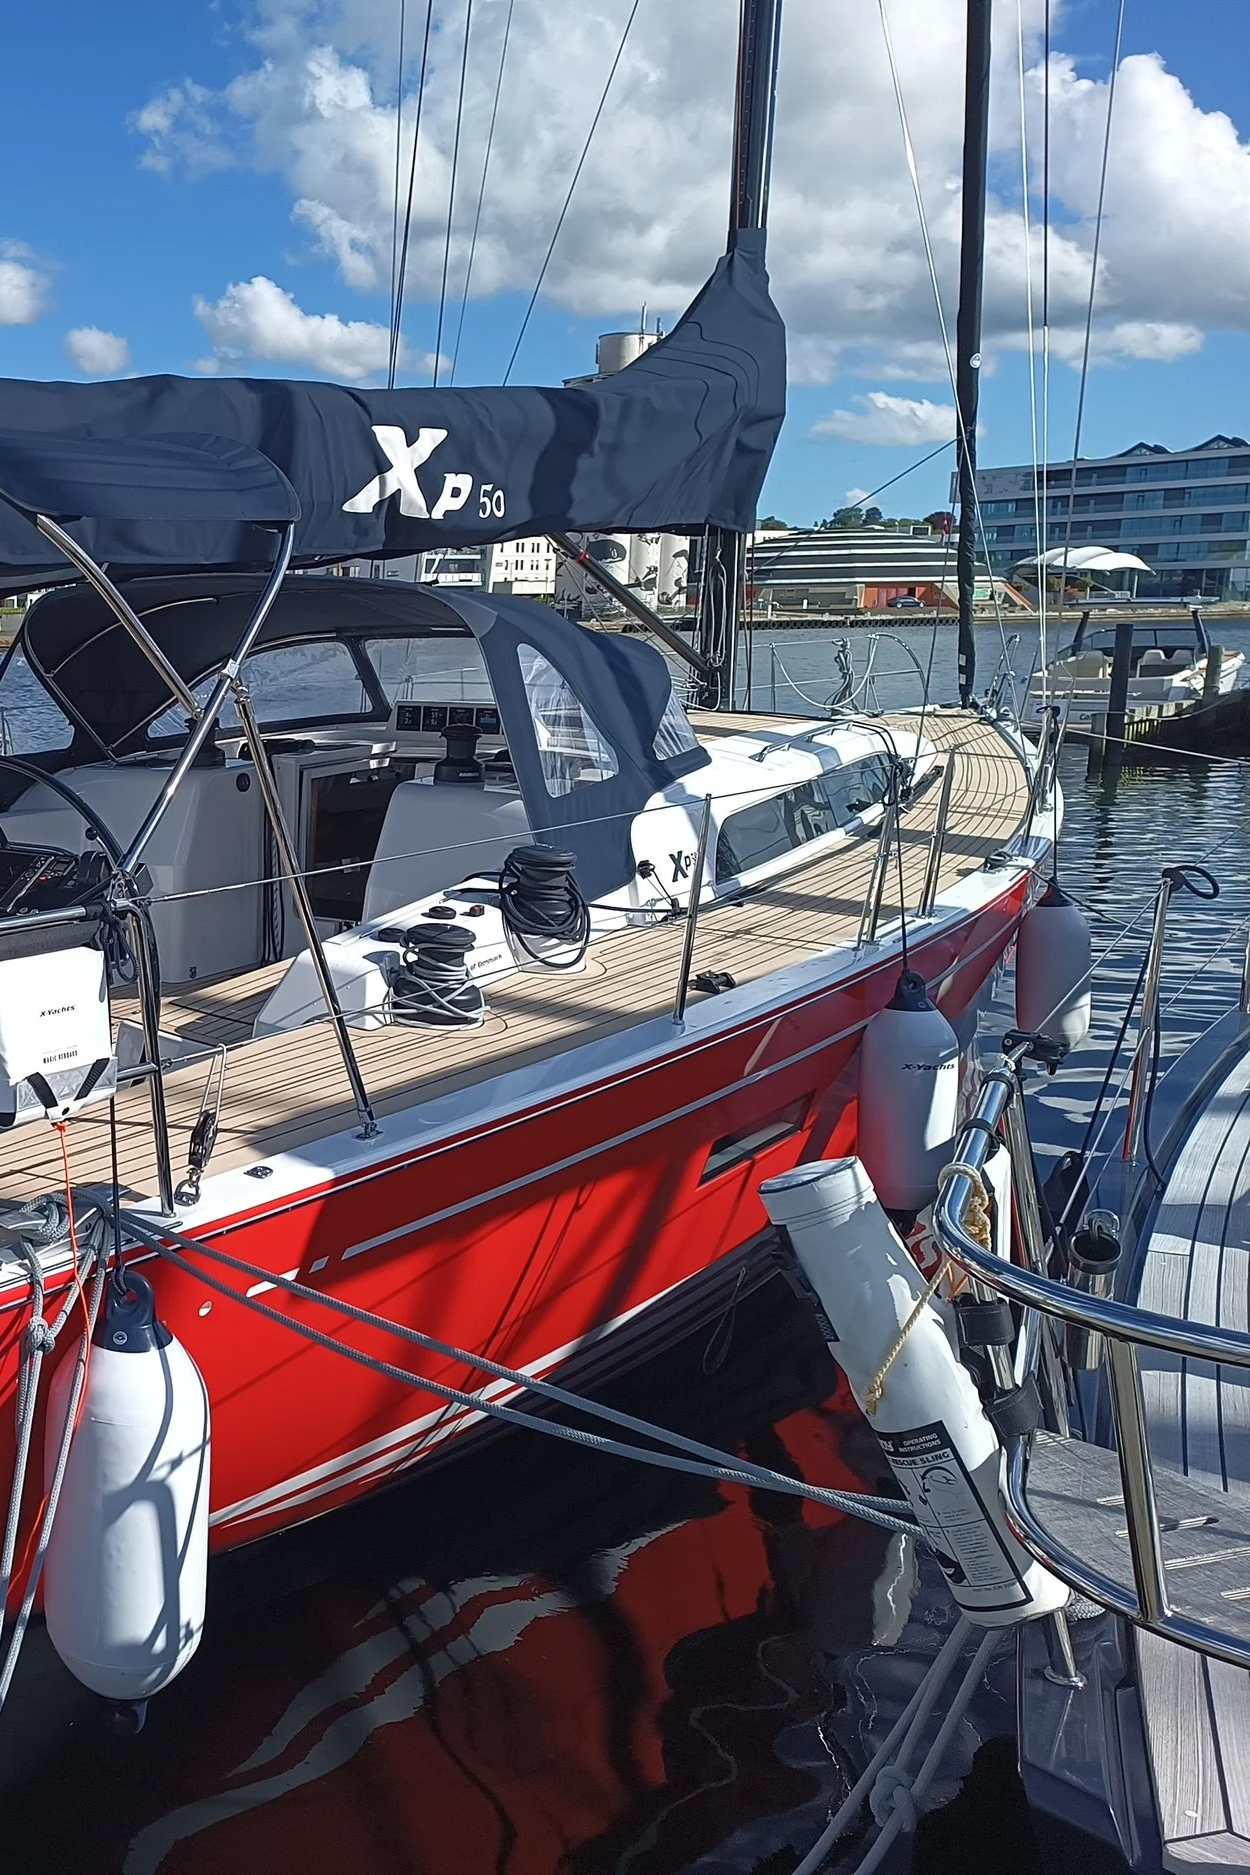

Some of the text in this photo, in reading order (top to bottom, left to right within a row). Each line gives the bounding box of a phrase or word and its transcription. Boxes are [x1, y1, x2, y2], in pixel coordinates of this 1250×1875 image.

[479, 484, 504, 518] 50
[40, 1004, 76, 1017] X-Yachts
[901, 1063, 955, 1071] X-Yachts
[898, 1439, 942, 1453] INSTRUCTIONS
[902, 1432, 938, 1447] OPERATING
[919, 1451, 950, 1464] SLING
